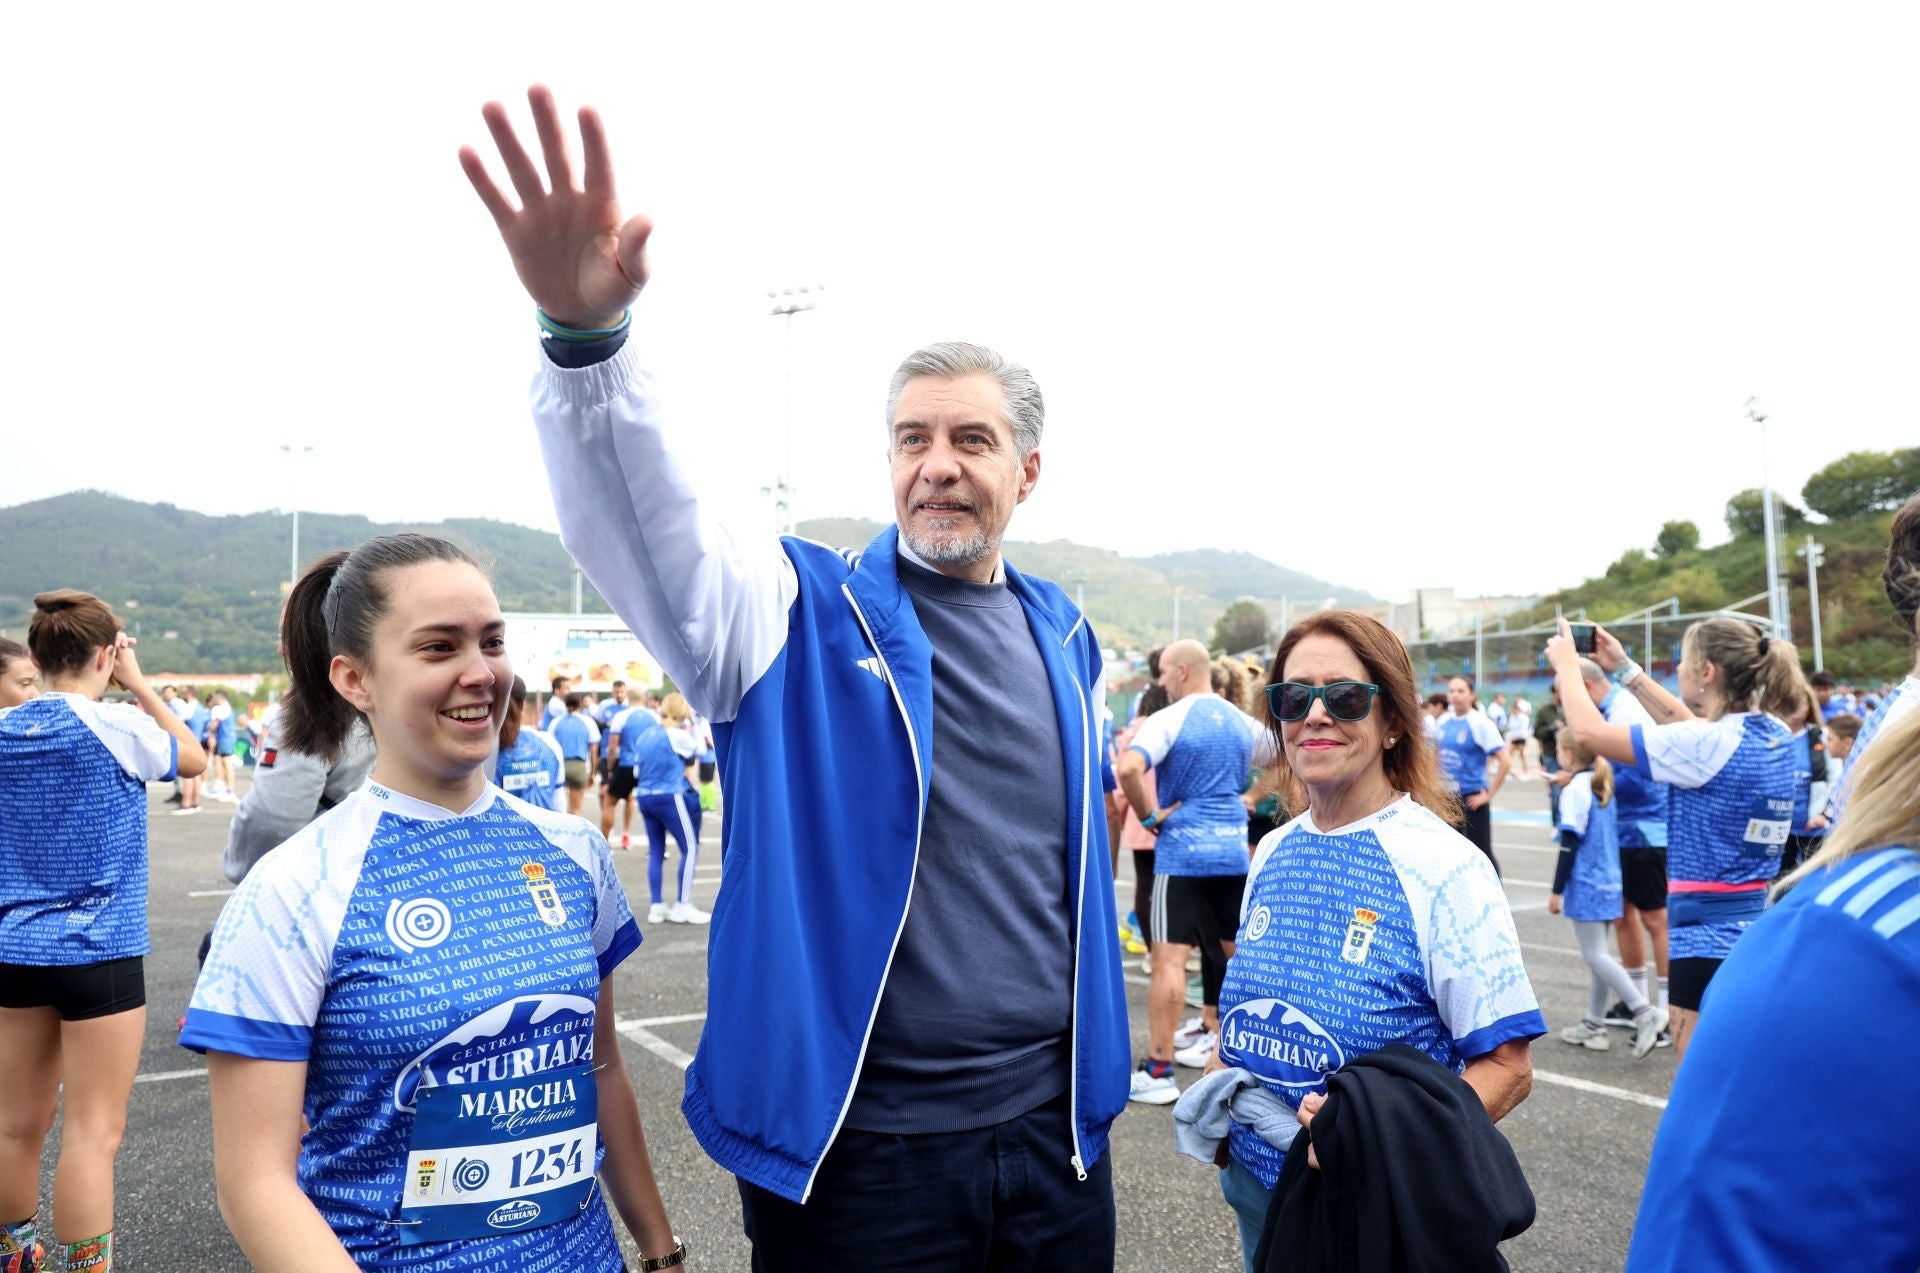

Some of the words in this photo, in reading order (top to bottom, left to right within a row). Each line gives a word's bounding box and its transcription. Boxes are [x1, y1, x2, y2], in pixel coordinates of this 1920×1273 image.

[369, 785, 390, 800] 1926
[1376, 809, 1398, 822] 2026
[392, 828, 471, 859] TARAMUNDI
[483, 826, 532, 838] TEVERGA
[437, 841, 497, 861] VILLAYÓN
[503, 839, 541, 853] YERNES
[1318, 836, 1350, 849] LLANES
[383, 867, 449, 896] MIRANDA
[453, 856, 504, 875] BIMENES
[440, 874, 493, 893] CARAVIA
[549, 863, 576, 875] CASO
[1310, 859, 1341, 872] QUIRÓS
[1354, 894, 1401, 914] SARIEGO
[1372, 887, 1394, 900] DEL
[500, 899, 532, 914] ILLAS
[484, 914, 527, 933] MUROS
[377, 965, 453, 987] RIBADEVA
[459, 942, 546, 971] RIBADESELLA
[436, 943, 471, 961] ALTA
[356, 987, 416, 1007] MARTÍN
[420, 982, 450, 998] DEL
[452, 974, 478, 990] REY
[482, 959, 537, 982] AURELIO
[544, 950, 567, 966] SAN
[1291, 967, 1325, 982] MORCÍN
[1332, 978, 1371, 995] MUROS
[379, 999, 450, 1022] SARIEGO
[462, 984, 503, 1005] SIERO
[513, 961, 593, 990] SOBRESCOBIO
[1287, 993, 1351, 1018] RIBADESELLA
[355, 1016, 448, 1041] TARAMUNDI
[1243, 1019, 1280, 1035] CENTRAL
[1283, 1029, 1327, 1049] LECHERA
[1352, 1024, 1374, 1036] SAN
[452, 1032, 527, 1062] CENTRAL
[1224, 1017, 1330, 1073] ASTURIANA
[458, 1079, 577, 1118] MARCHA
[509, 1139, 583, 1189] 1234
[492, 1209, 537, 1224] ASTURIANA
